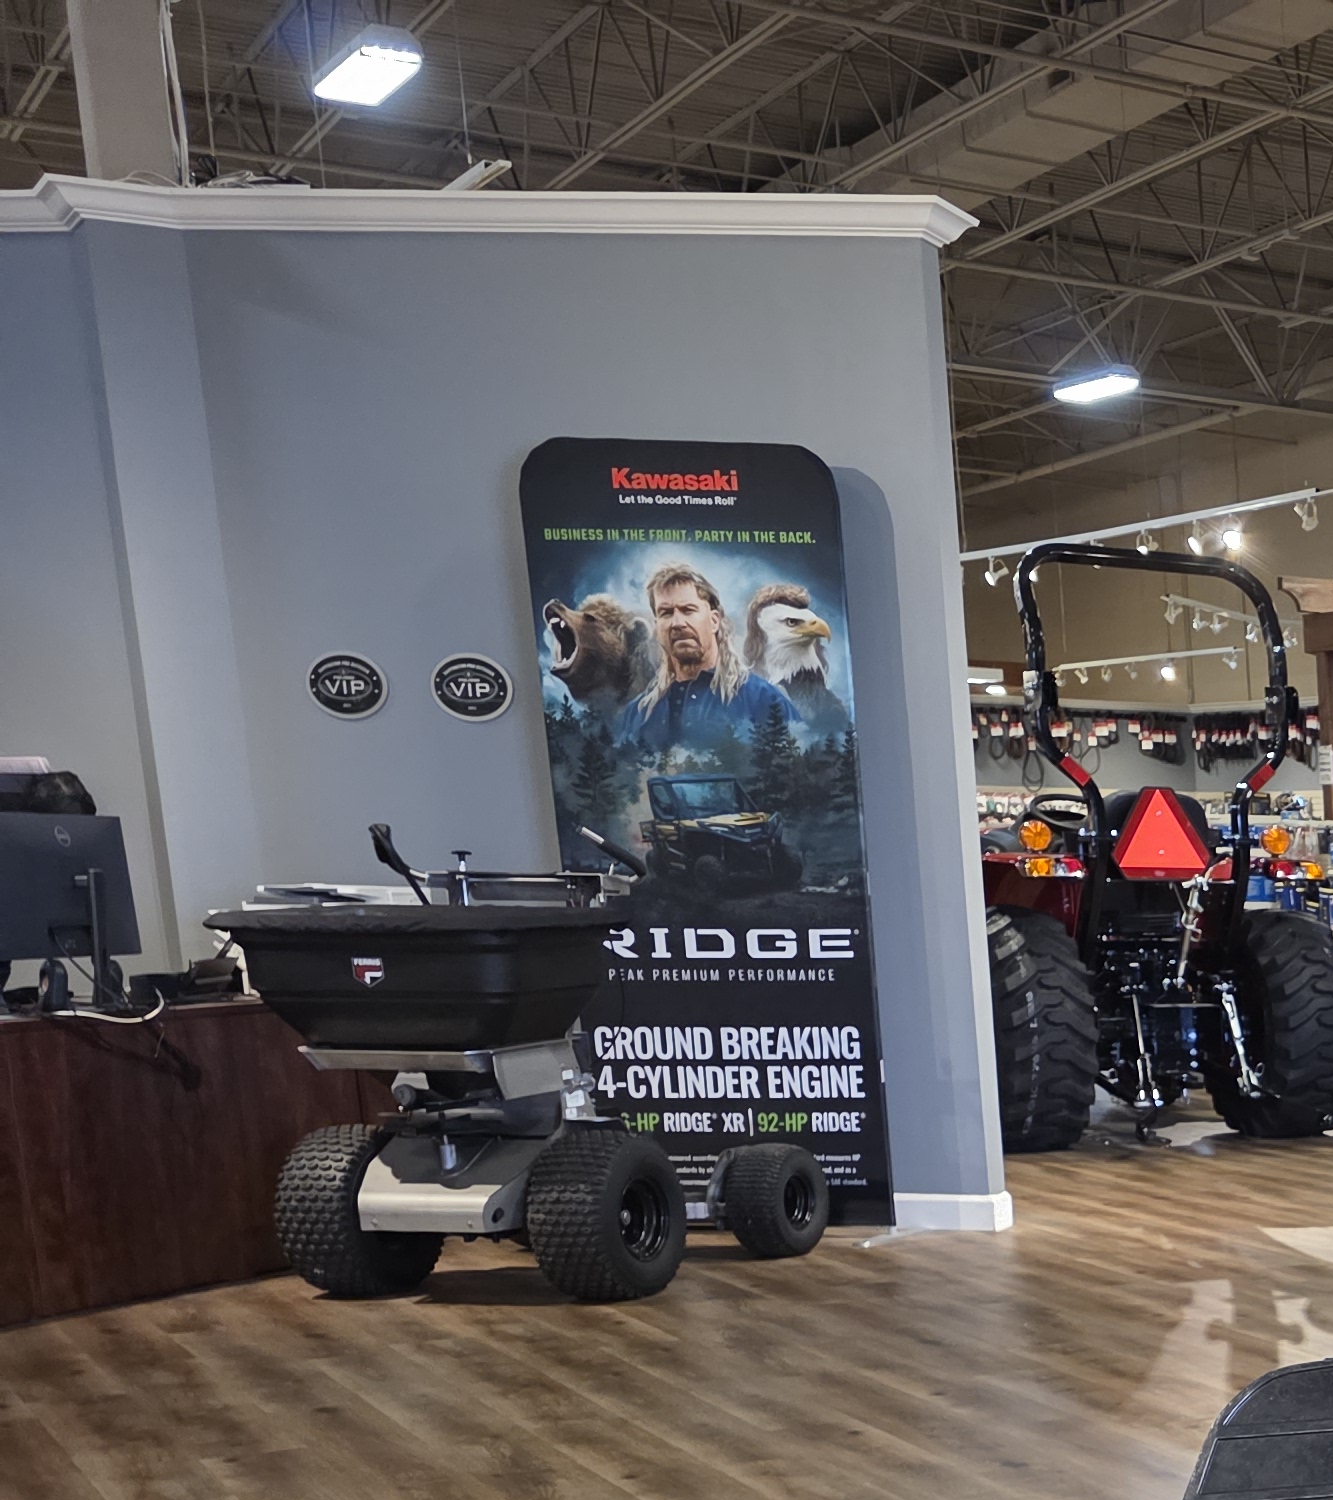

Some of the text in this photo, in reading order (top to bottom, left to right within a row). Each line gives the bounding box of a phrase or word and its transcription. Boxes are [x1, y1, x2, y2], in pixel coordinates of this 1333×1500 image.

[611, 467, 738, 491] Kawasaki
[619, 494, 635, 504] Let
[637, 494, 653, 504] the
[655, 495, 681, 505] Good
[683, 495, 713, 505] Times
[544, 528, 603, 541] BUSINESS
[607, 529, 620, 541] IN
[623, 529, 645, 541] THE
[695, 531, 733, 542] PARTY
[737, 531, 750, 542] IN
[753, 531, 776, 543] THE
[779, 532, 816, 543] BACK.
[325, 679, 365, 694] VIP
[450, 682, 490, 697] VIP
[602, 928, 855, 958] RIDGE
[652, 969, 720, 981] PREMIUM
[728, 969, 835, 981] PERFORMANCE
[593, 1025, 861, 1060] GROUND BREAKING
[597, 1065, 866, 1099] 4-CYLINDER ENGINE
[663, 1112, 714, 1132] RIDGE
[721, 1112, 745, 1132] XR
[758, 1112, 808, 1132] 92-HP
[811, 1112, 861, 1132] RIDGE
